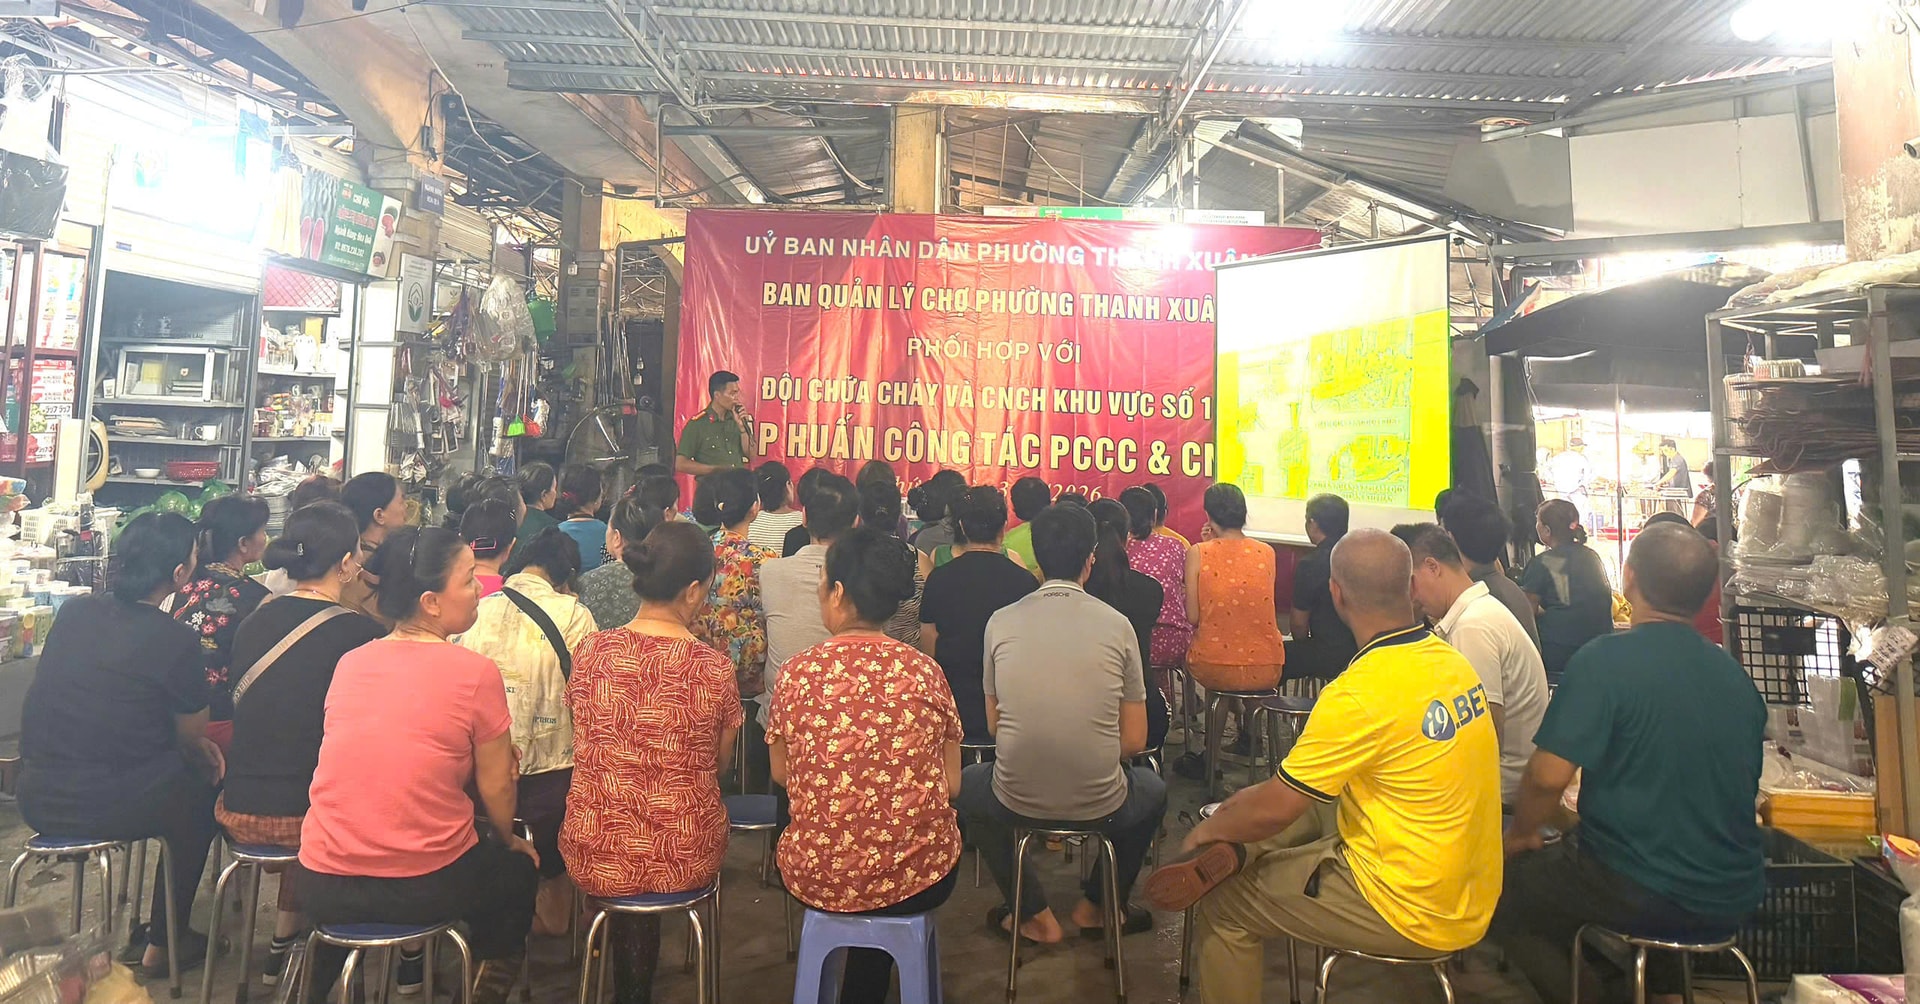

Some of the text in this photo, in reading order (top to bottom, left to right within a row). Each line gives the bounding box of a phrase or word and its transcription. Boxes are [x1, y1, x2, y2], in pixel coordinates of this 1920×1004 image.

[745, 230, 777, 255] UỶ
[784, 236, 834, 256] BAN
[842, 235, 910, 258] NHÂN
[918, 237, 969, 261] DÂN
[977, 241, 1084, 266] PHƯỜNG
[1091, 246, 1180, 270] THH
[762, 277, 1215, 323] BAN QUẢN LÝ CHỢ PHƯỜNG THANH XUÂ
[907, 333, 1081, 364] PHỐI HỢP VỚI
[762, 372, 802, 406] ĐỘI
[808, 374, 870, 404] CHỮA
[877, 377, 939, 406] CHÁY
[945, 380, 974, 408] VÀ
[981, 386, 1046, 412] CNCH
[1053, 388, 1100, 414] KHU
[1108, 391, 1155, 421] VỰC
[1161, 386, 1195, 420] SỐ
[787, 414, 875, 460] HUẤN
[884, 421, 970, 465] CÔNG
[981, 426, 1041, 469] TÁC
[1050, 434, 1138, 473] PCCC
[1147, 440, 1171, 476] &
